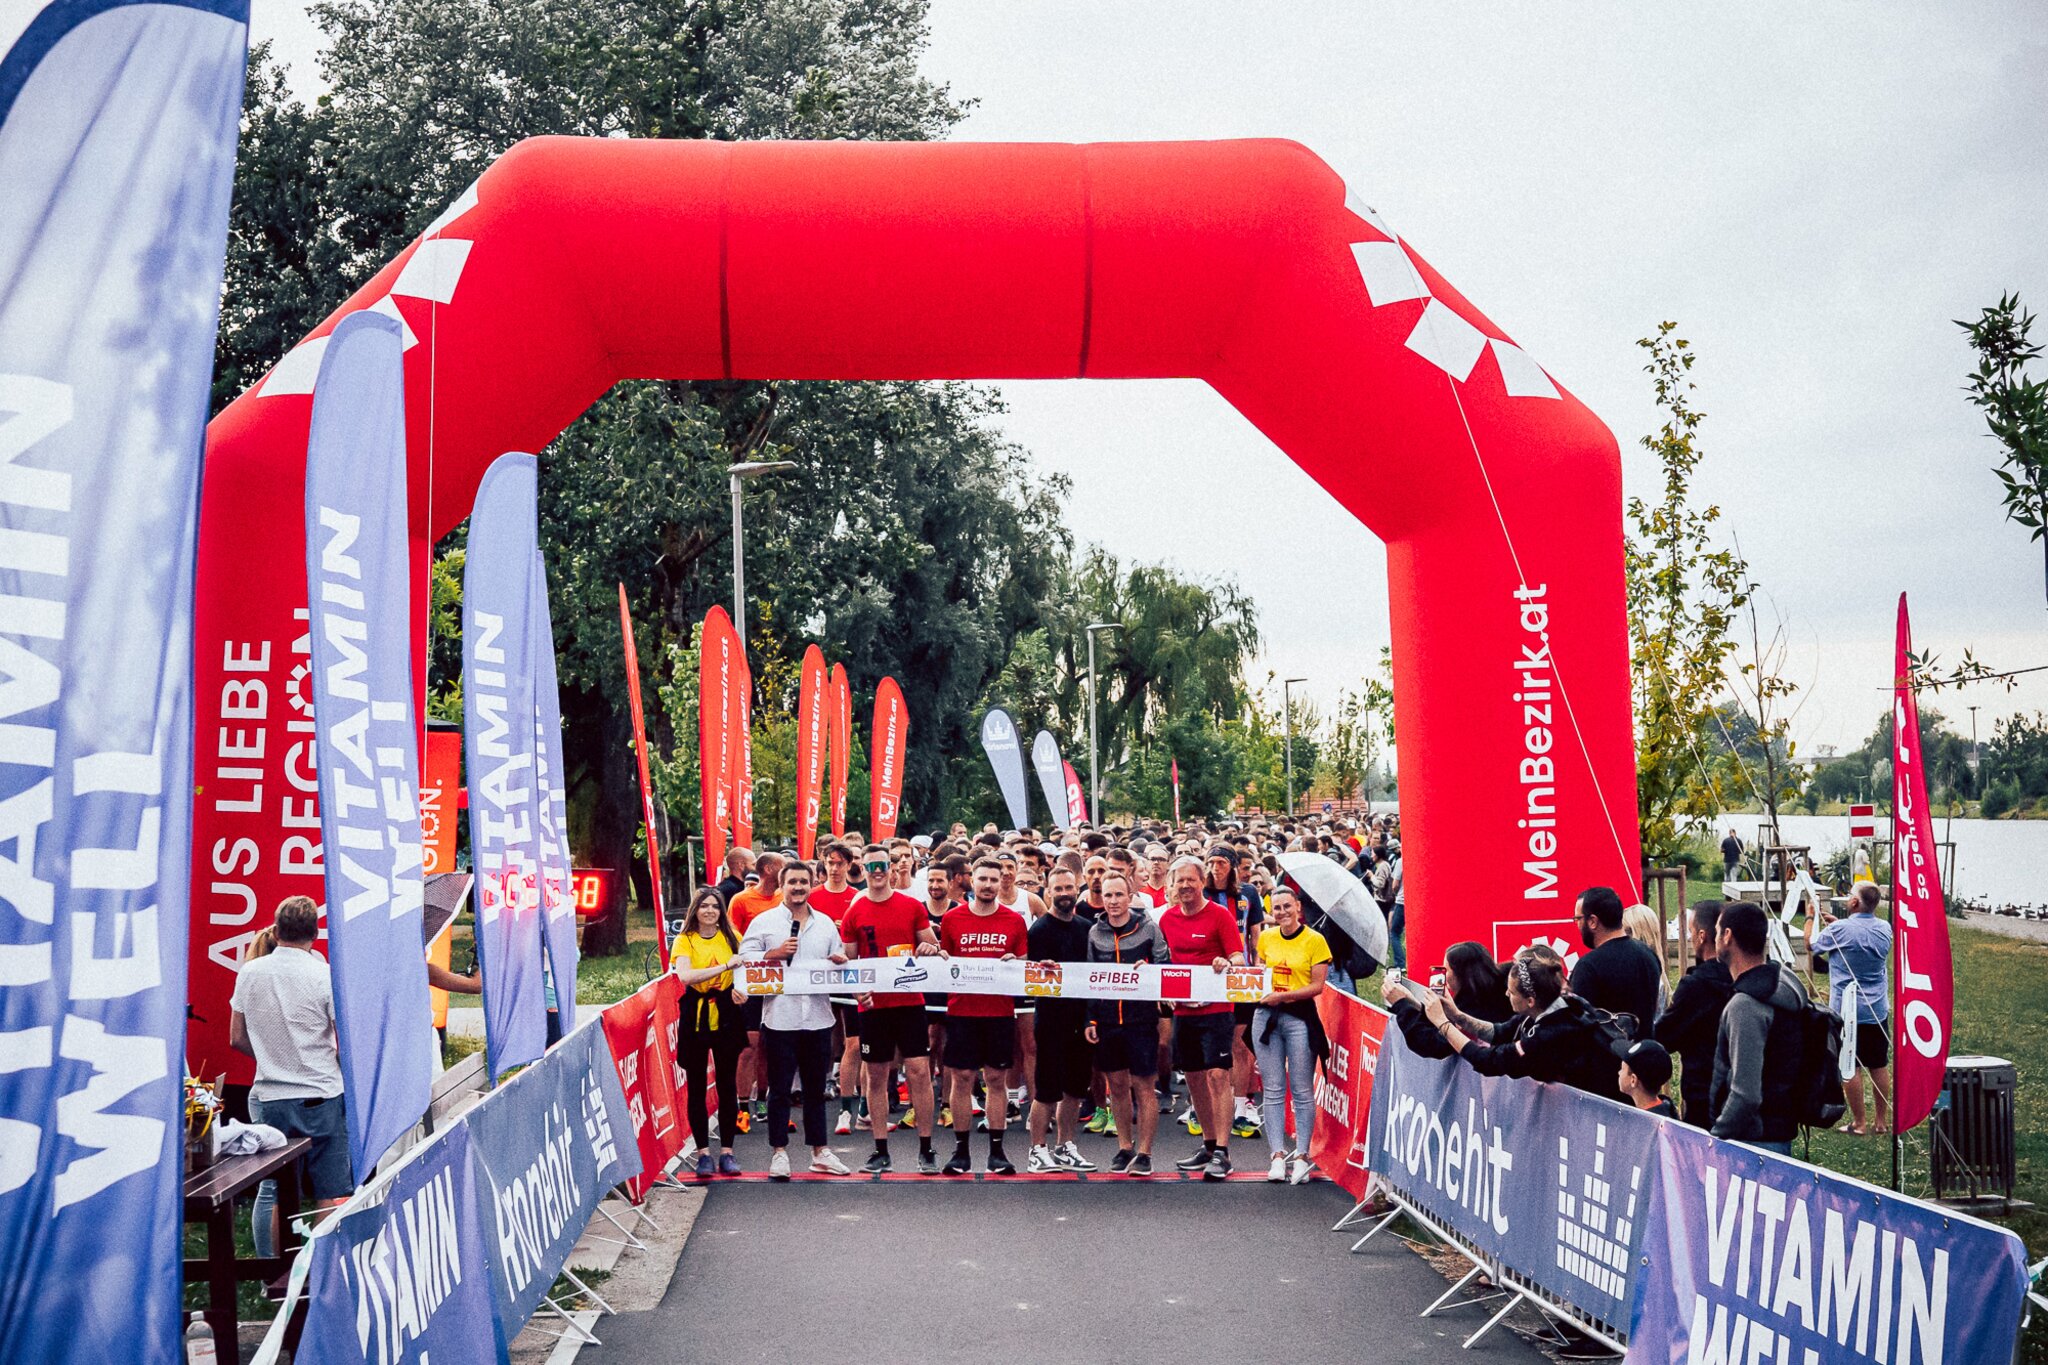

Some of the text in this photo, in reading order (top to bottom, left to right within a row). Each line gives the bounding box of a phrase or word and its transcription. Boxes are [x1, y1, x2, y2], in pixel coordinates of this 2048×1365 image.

[320, 506, 389, 922] VITAMIN
[474, 610, 508, 925] VITAMIN
[881, 697, 898, 789] MeinBezirk.at
[1513, 583, 1559, 900] MeinBezirk.at
[208, 640, 272, 976] AUS LIEBE
[960, 933, 1008, 945] öFIBER
[54, 728, 168, 1219] WELL
[746, 969, 784, 984] RUN
[746, 983, 784, 995] GRAZ
[811, 970, 875, 984] GRAZ
[1024, 969, 1063, 984] RUN
[1024, 984, 1062, 996] GRAZ
[1089, 971, 1140, 984] öFIBER
[1226, 975, 1263, 990] RUN
[1383, 1055, 1513, 1236] kronehit
[1704, 1165, 1950, 1365] VITAMIN
